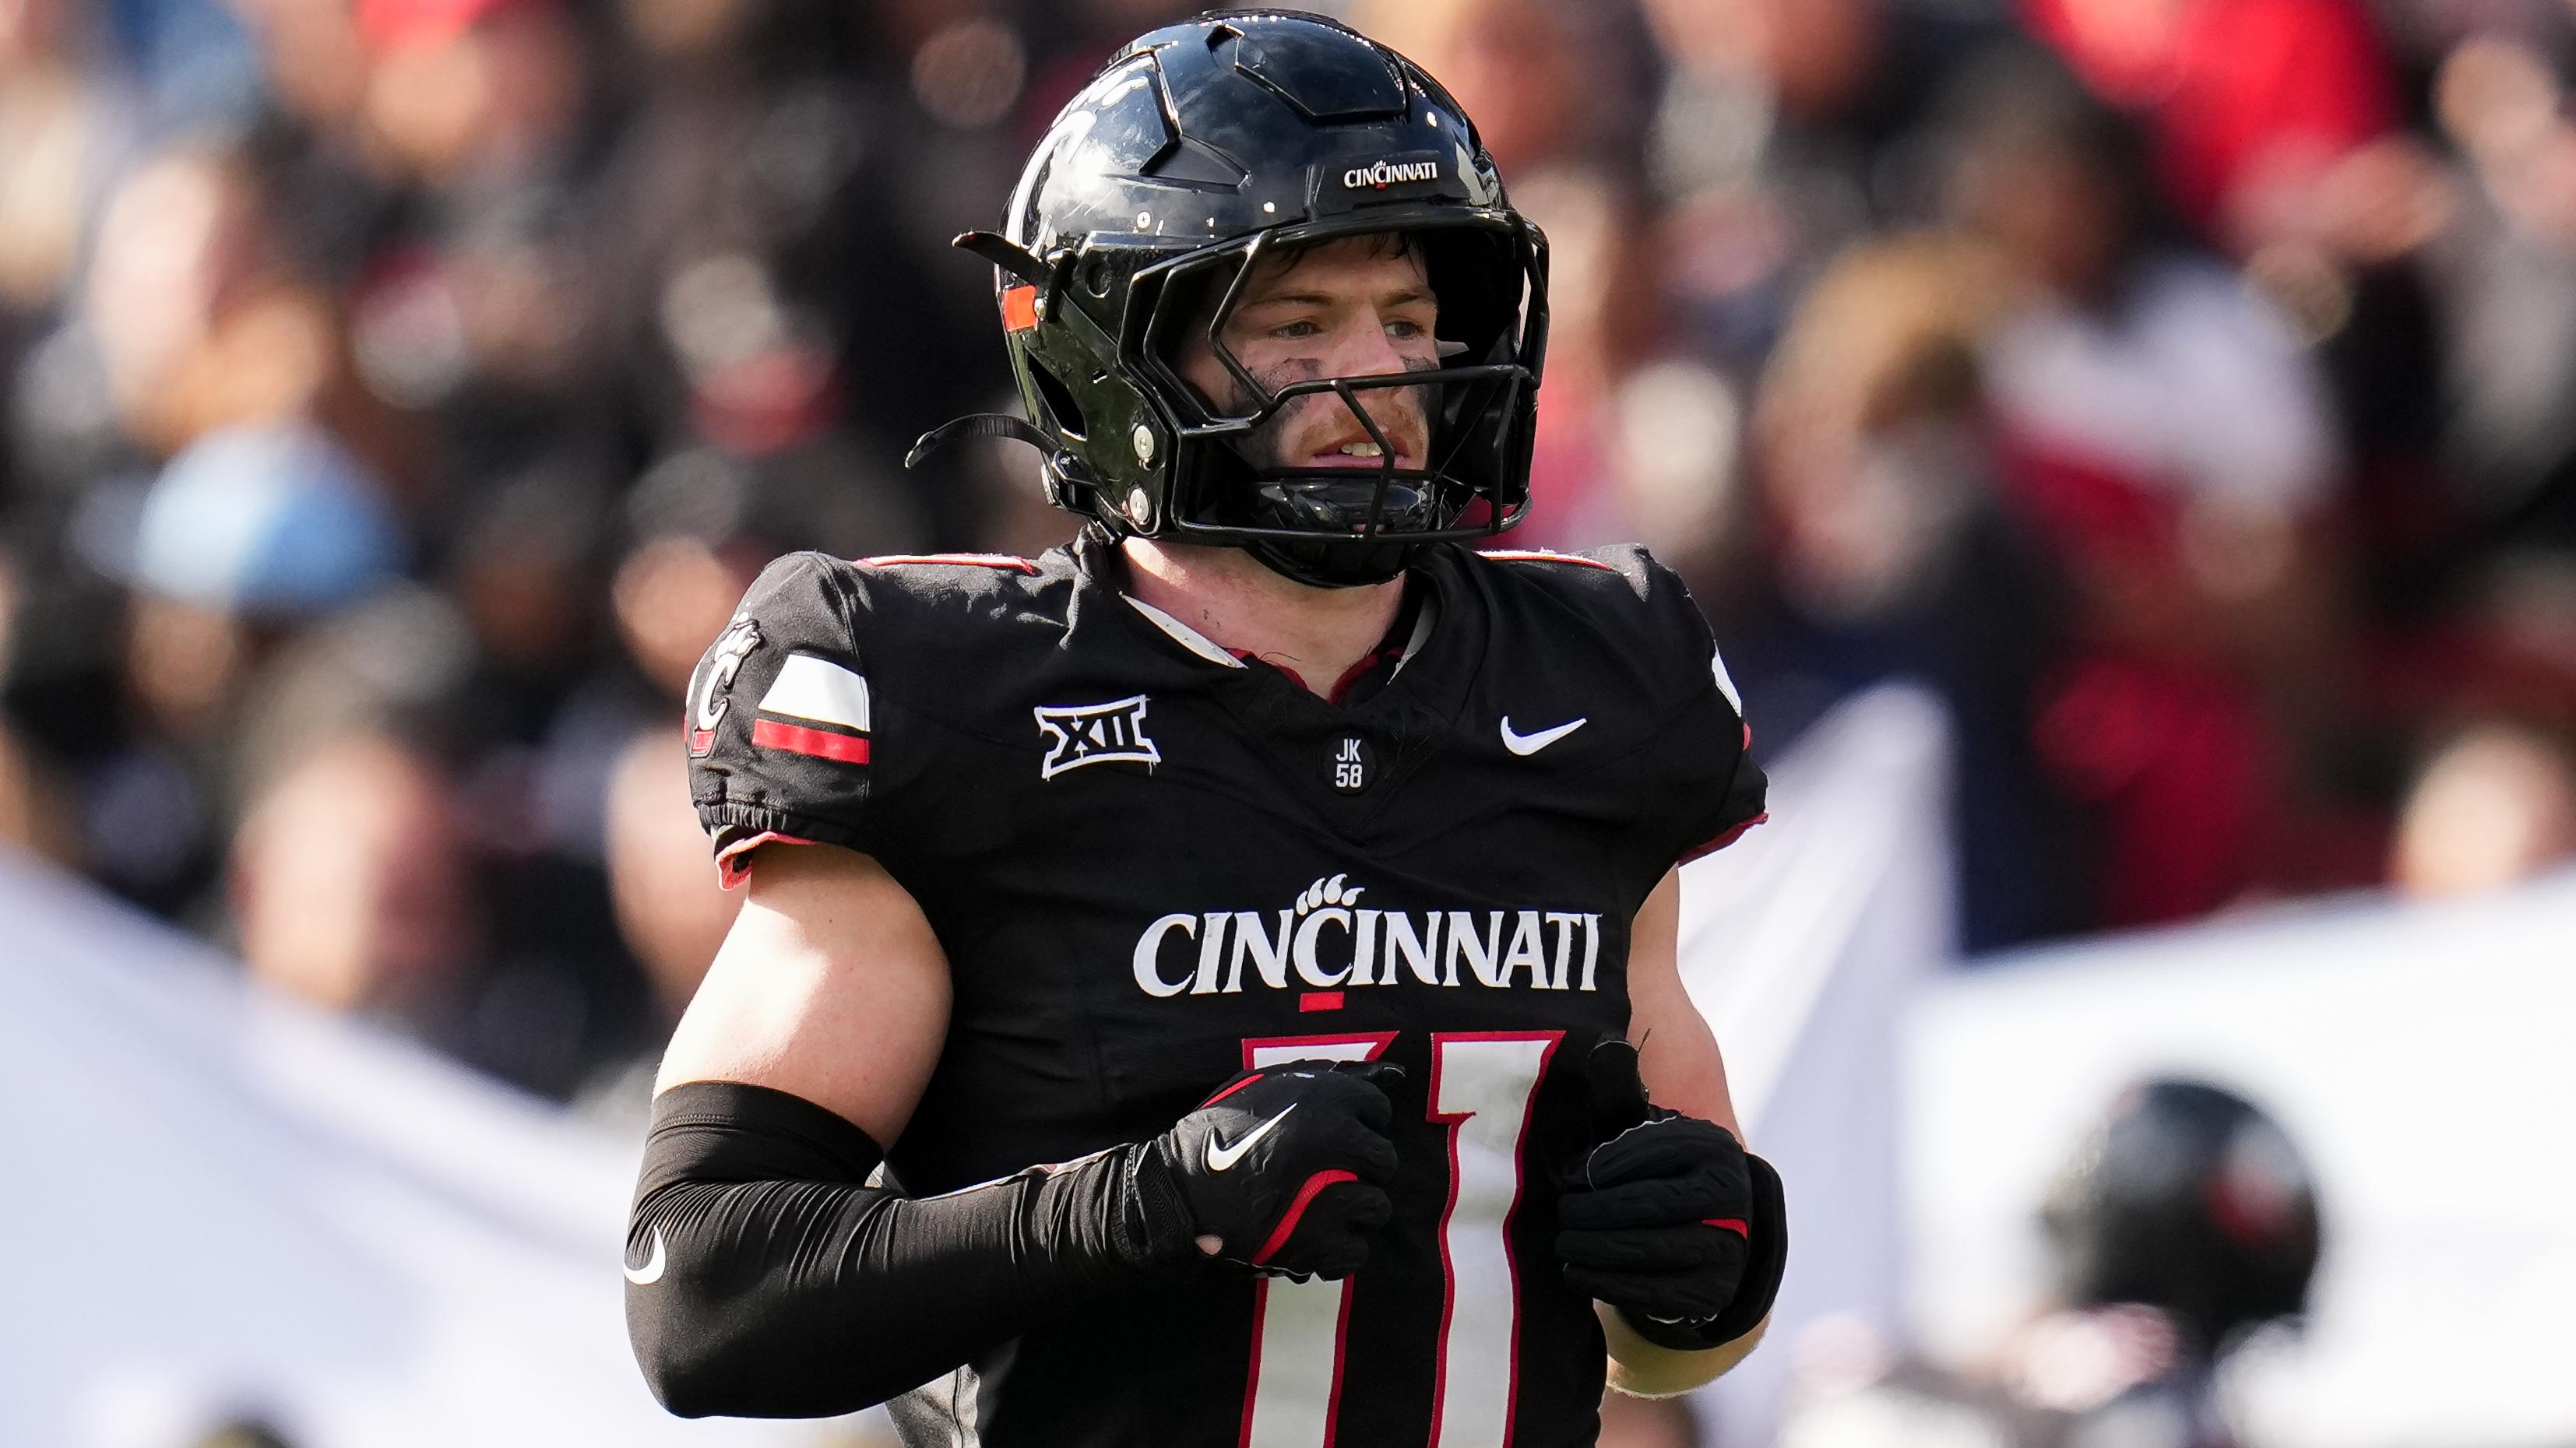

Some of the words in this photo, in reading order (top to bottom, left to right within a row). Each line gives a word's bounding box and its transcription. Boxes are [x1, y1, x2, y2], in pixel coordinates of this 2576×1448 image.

[1344, 160, 1438, 188] CINCINNATI
[1336, 739, 1361, 761] JK
[1336, 764, 1362, 787] 58
[1133, 906, 1601, 997] CINCINNATI
